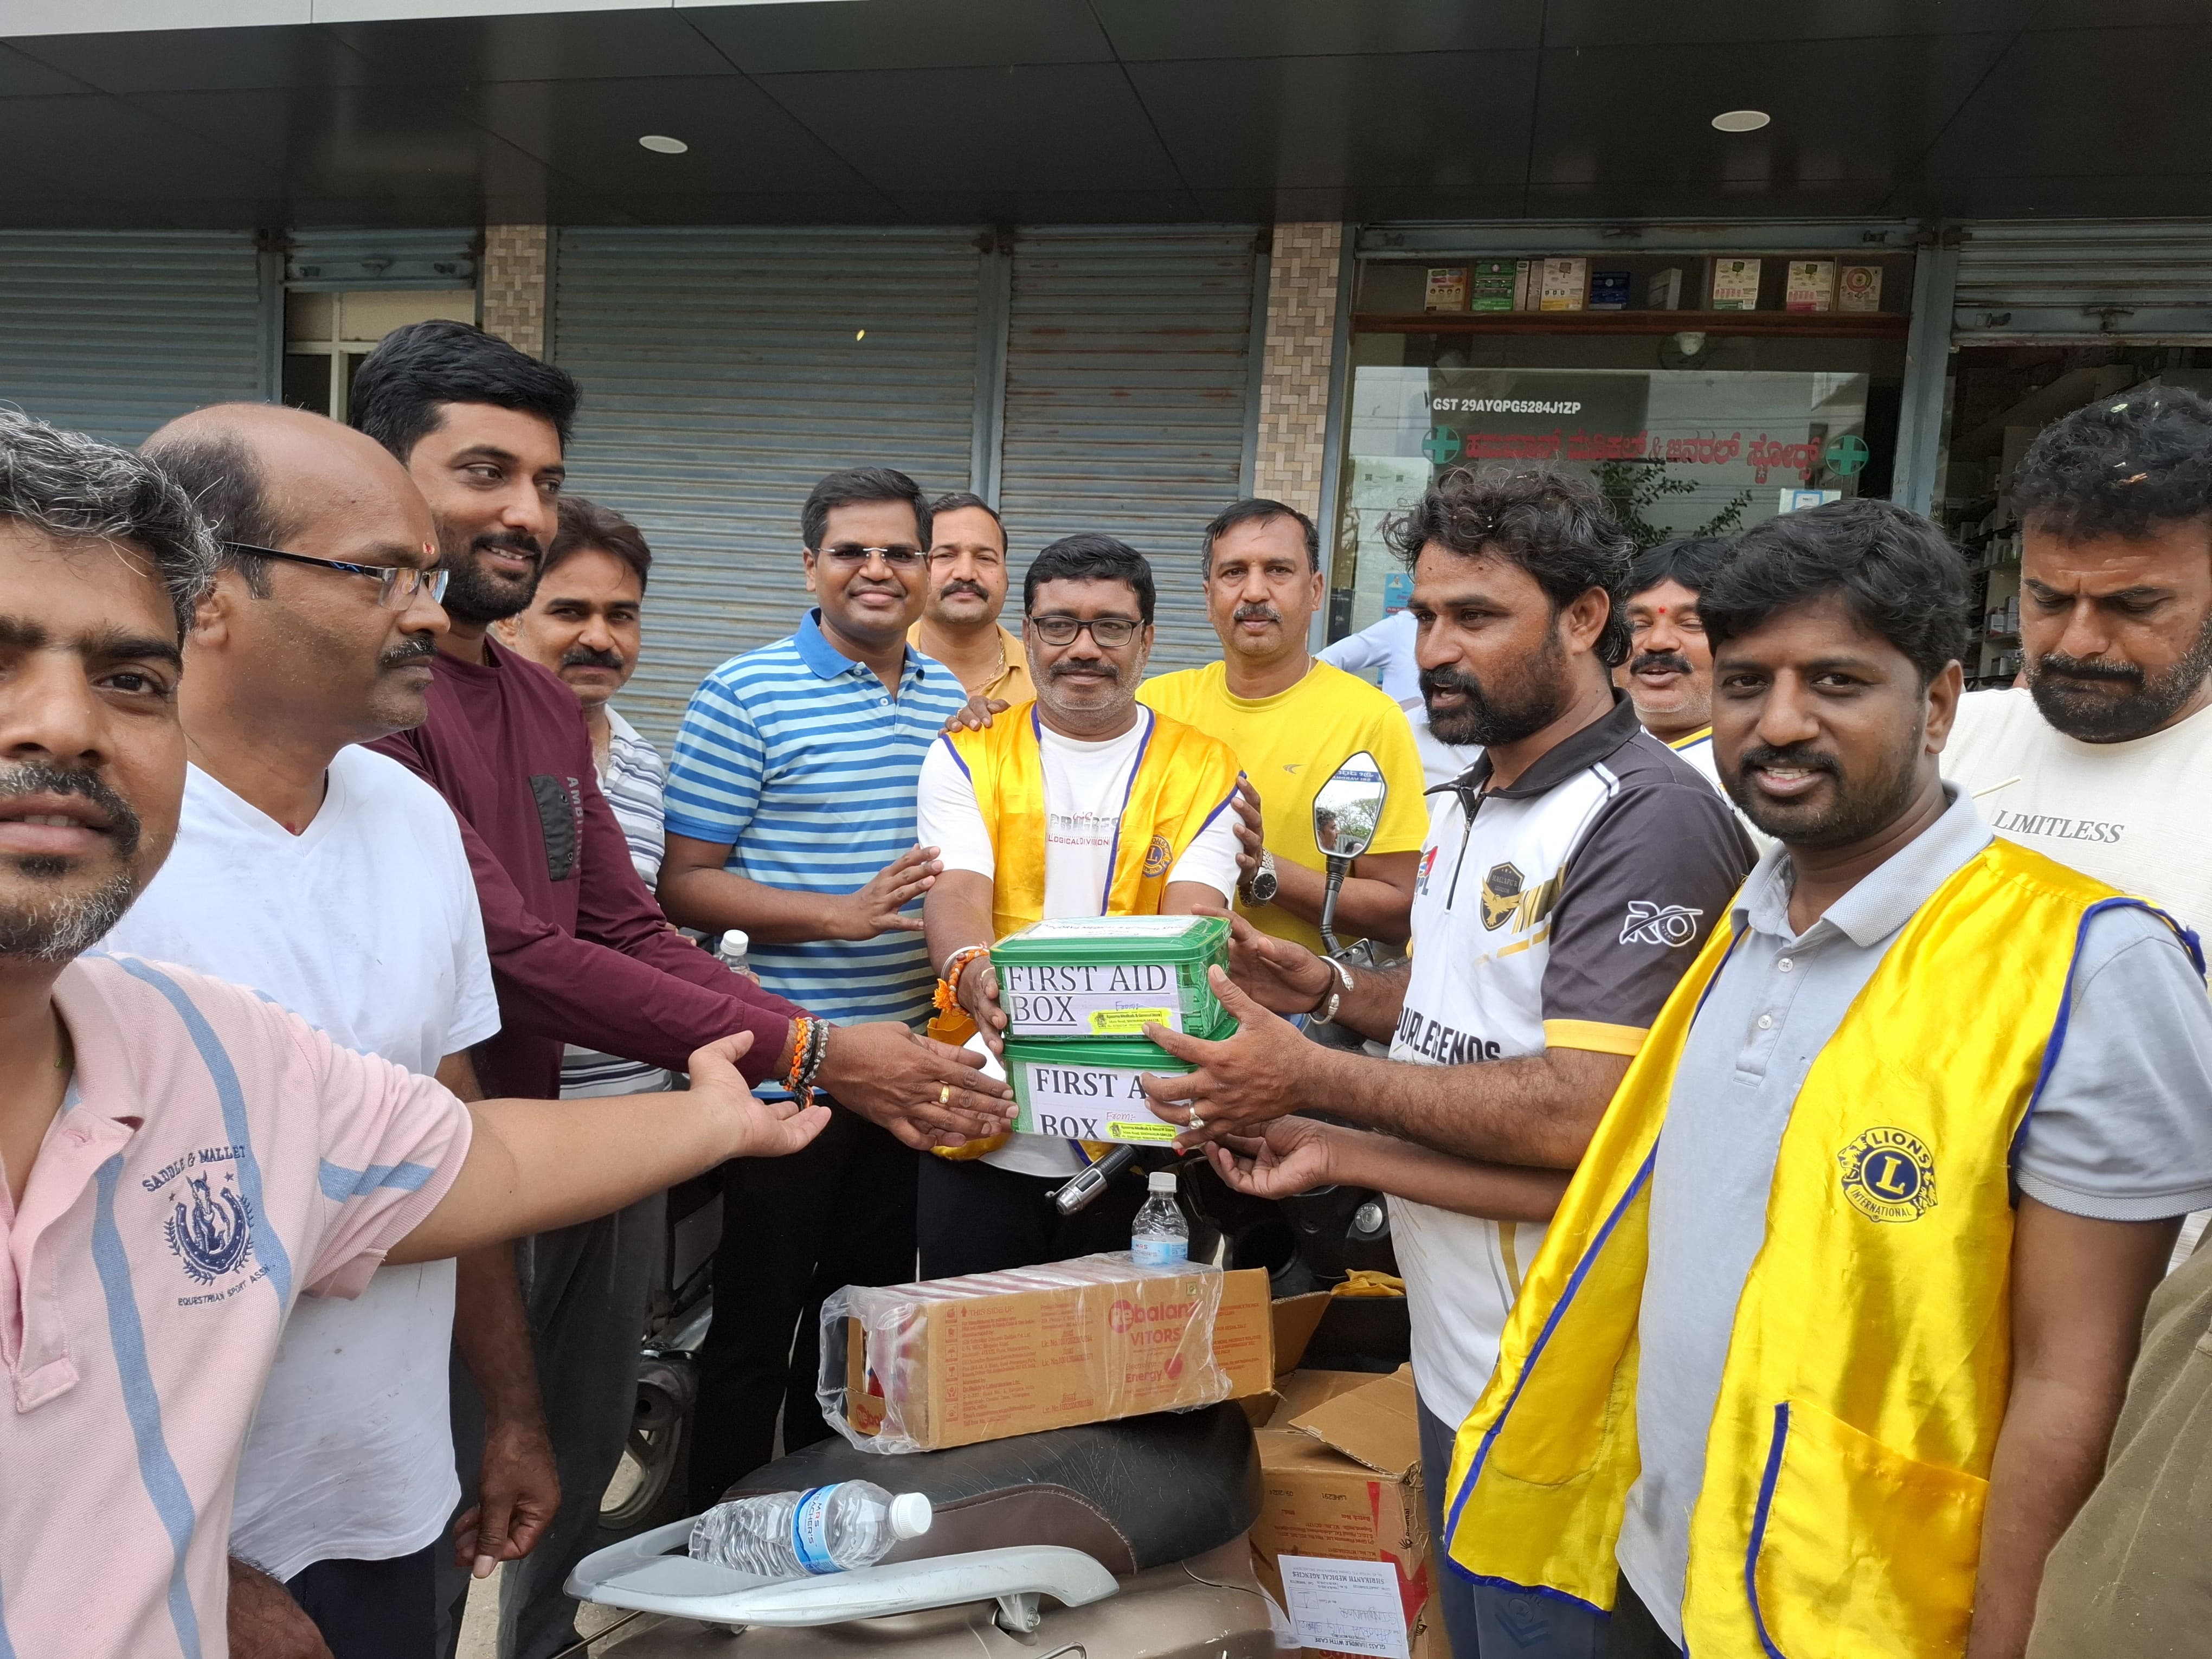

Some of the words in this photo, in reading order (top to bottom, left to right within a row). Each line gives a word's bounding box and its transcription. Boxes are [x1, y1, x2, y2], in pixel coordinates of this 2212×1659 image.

[1432, 398, 1458, 410] GST
[1991, 810, 2125, 844] LIMITLESS
[1008, 965, 1097, 992] FIRST
[1109, 964, 1167, 992] AID
[1013, 995, 1077, 1022] BOX
[1035, 1068, 1117, 1098] FIRST
[1039, 1114, 1099, 1139] BOX
[1871, 1130, 1930, 1164] LIONS
[142, 1157, 185, 1192] SADDLE
[187, 1153, 195, 1167] &
[198, 1145, 246, 1163] MALLET
[1875, 1155, 1905, 1195] L
[1850, 1189, 1912, 1217] INTERNATIONAL
[178, 1291, 225, 1307] EQUESTRIAN
[227, 1280, 247, 1297] SPORT
[1130, 1328, 1181, 1346] VITORS
[1126, 1370, 1162, 1383] Energy
[807, 1492, 822, 1544] TEACHER'S
[814, 1503, 823, 1527] MRS
[1293, 1571, 1321, 1580] AGENCIES
[1323, 1573, 1347, 1581] MEDICAL
[1349, 1575, 1384, 1584] SHRIKANTH
